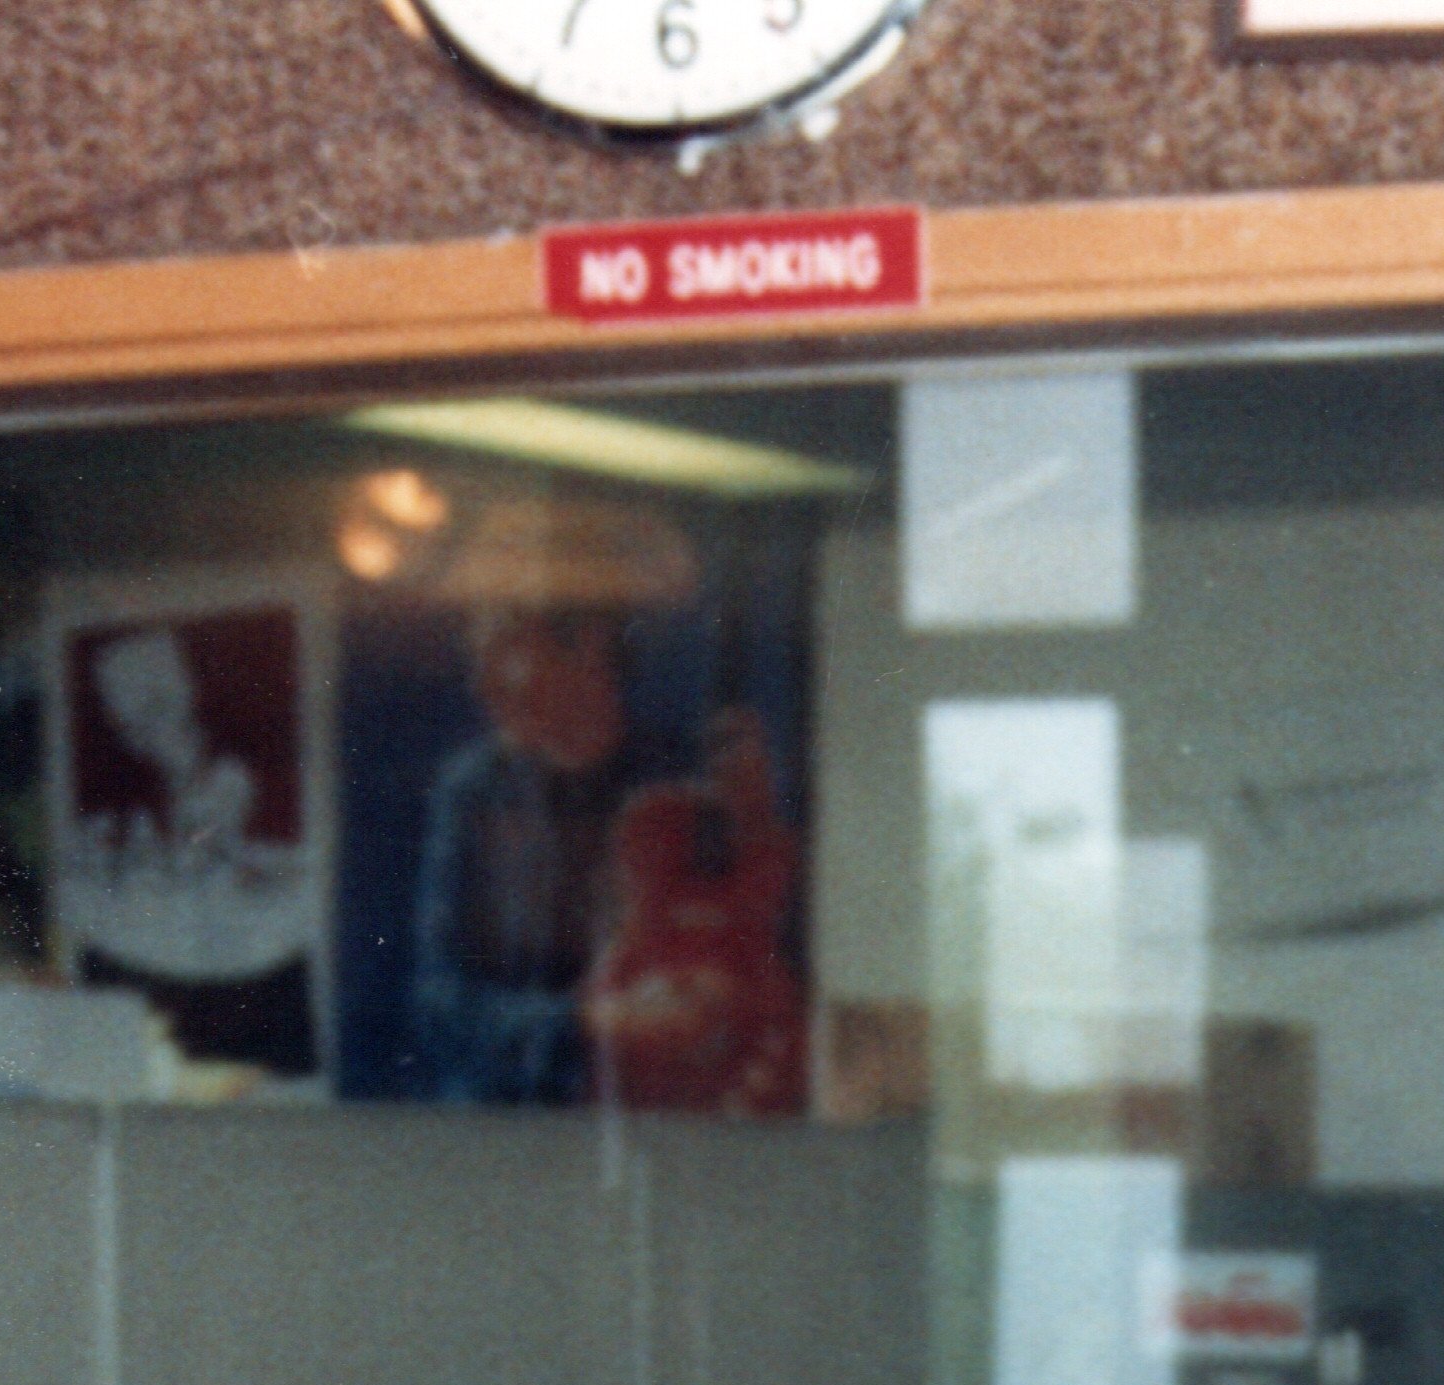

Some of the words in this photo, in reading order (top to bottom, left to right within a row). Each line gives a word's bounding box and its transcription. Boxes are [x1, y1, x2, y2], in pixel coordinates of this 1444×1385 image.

[657, 0, 699, 69] 6
[579, 245, 648, 302] NO
[668, 231, 882, 301] SMOKING
